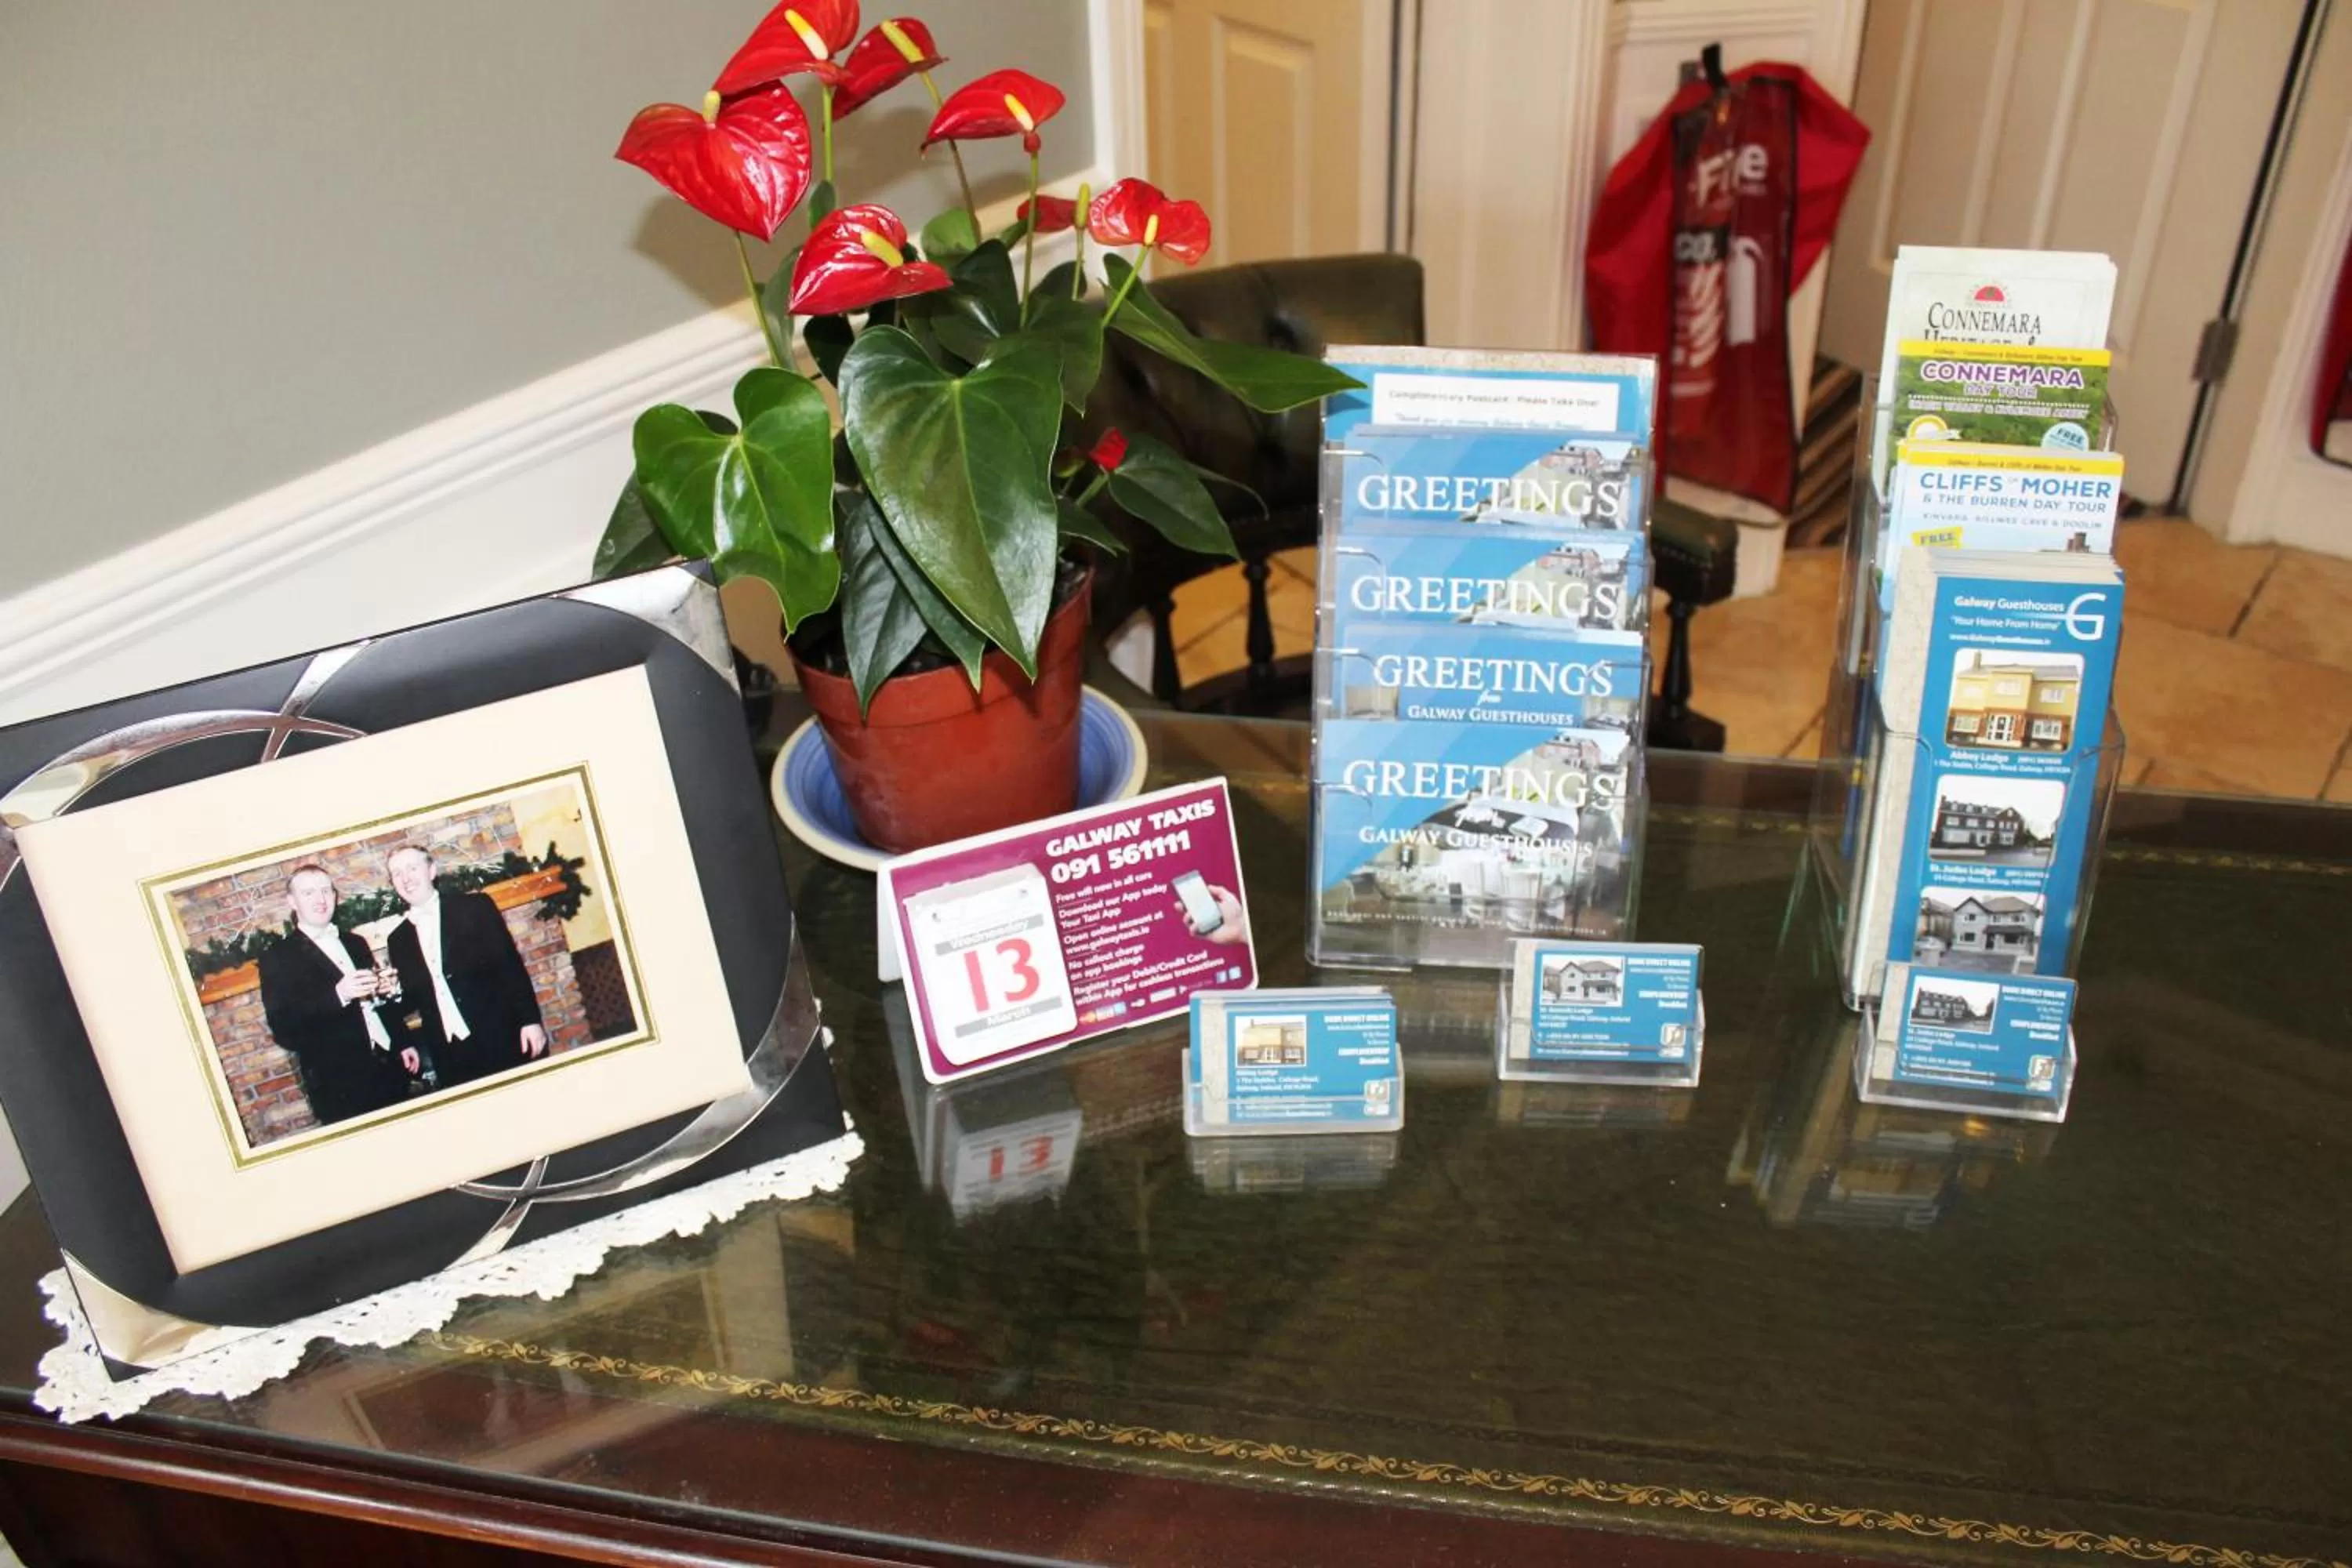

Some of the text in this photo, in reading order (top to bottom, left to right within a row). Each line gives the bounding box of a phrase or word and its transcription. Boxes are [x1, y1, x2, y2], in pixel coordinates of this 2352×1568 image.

[1928, 301, 2042, 335] CONNEMARA
[1923, 361, 2083, 388] CONNEMARA
[1517, 396, 1548, 405] Please
[1965, 384, 2038, 398] DAY TOUR
[2056, 426, 2084, 445] FREE
[1357, 474, 1626, 518] GREETINGS
[1920, 472, 2002, 492] CLIFFS
[2022, 477, 2111, 499] MOHER
[1938, 493, 1965, 505] THE
[1970, 495, 2028, 509] BURREN
[2034, 499, 2062, 510] DAY
[2068, 501, 2107, 514] TOUR
[1920, 532, 1955, 546] FREE
[1351, 574, 1620, 621] GREETINGS
[1954, 595, 2065, 612] Galway Guesthouses
[1374, 655, 1613, 698] GREETINGS
[1407, 705, 1574, 726] GALWAY GUESTHOUSES
[1343, 759, 1617, 812] GREETINGS
[1046, 798, 1215, 857] GALWAY TAXIS
[1359, 826, 1592, 858] GALWAY GUESTHOUSES
[1051, 829, 1191, 884] 091 561111
[1055, 893, 1076, 903] Free
[1113, 879, 1123, 888] in
[1123, 874, 1134, 885] all
[1135, 872, 1153, 883] cars
[1058, 884, 1167, 919] Download our App today
[1061, 907, 1121, 929] Your Taxi App
[1063, 910, 1164, 945] Open online account at
[1068, 944, 1145, 970] No callout charge
[1070, 954, 1144, 981] on app bookings
[1073, 949, 1208, 996] Register your Debit/Credit Card
[964, 936, 1041, 1014] 13
[1076, 993, 1102, 1007] within
[1104, 986, 1123, 999] App
[1124, 981, 1138, 993] for
[1138, 972, 1174, 989] cashless
[1173, 957, 1225, 978] transactions
